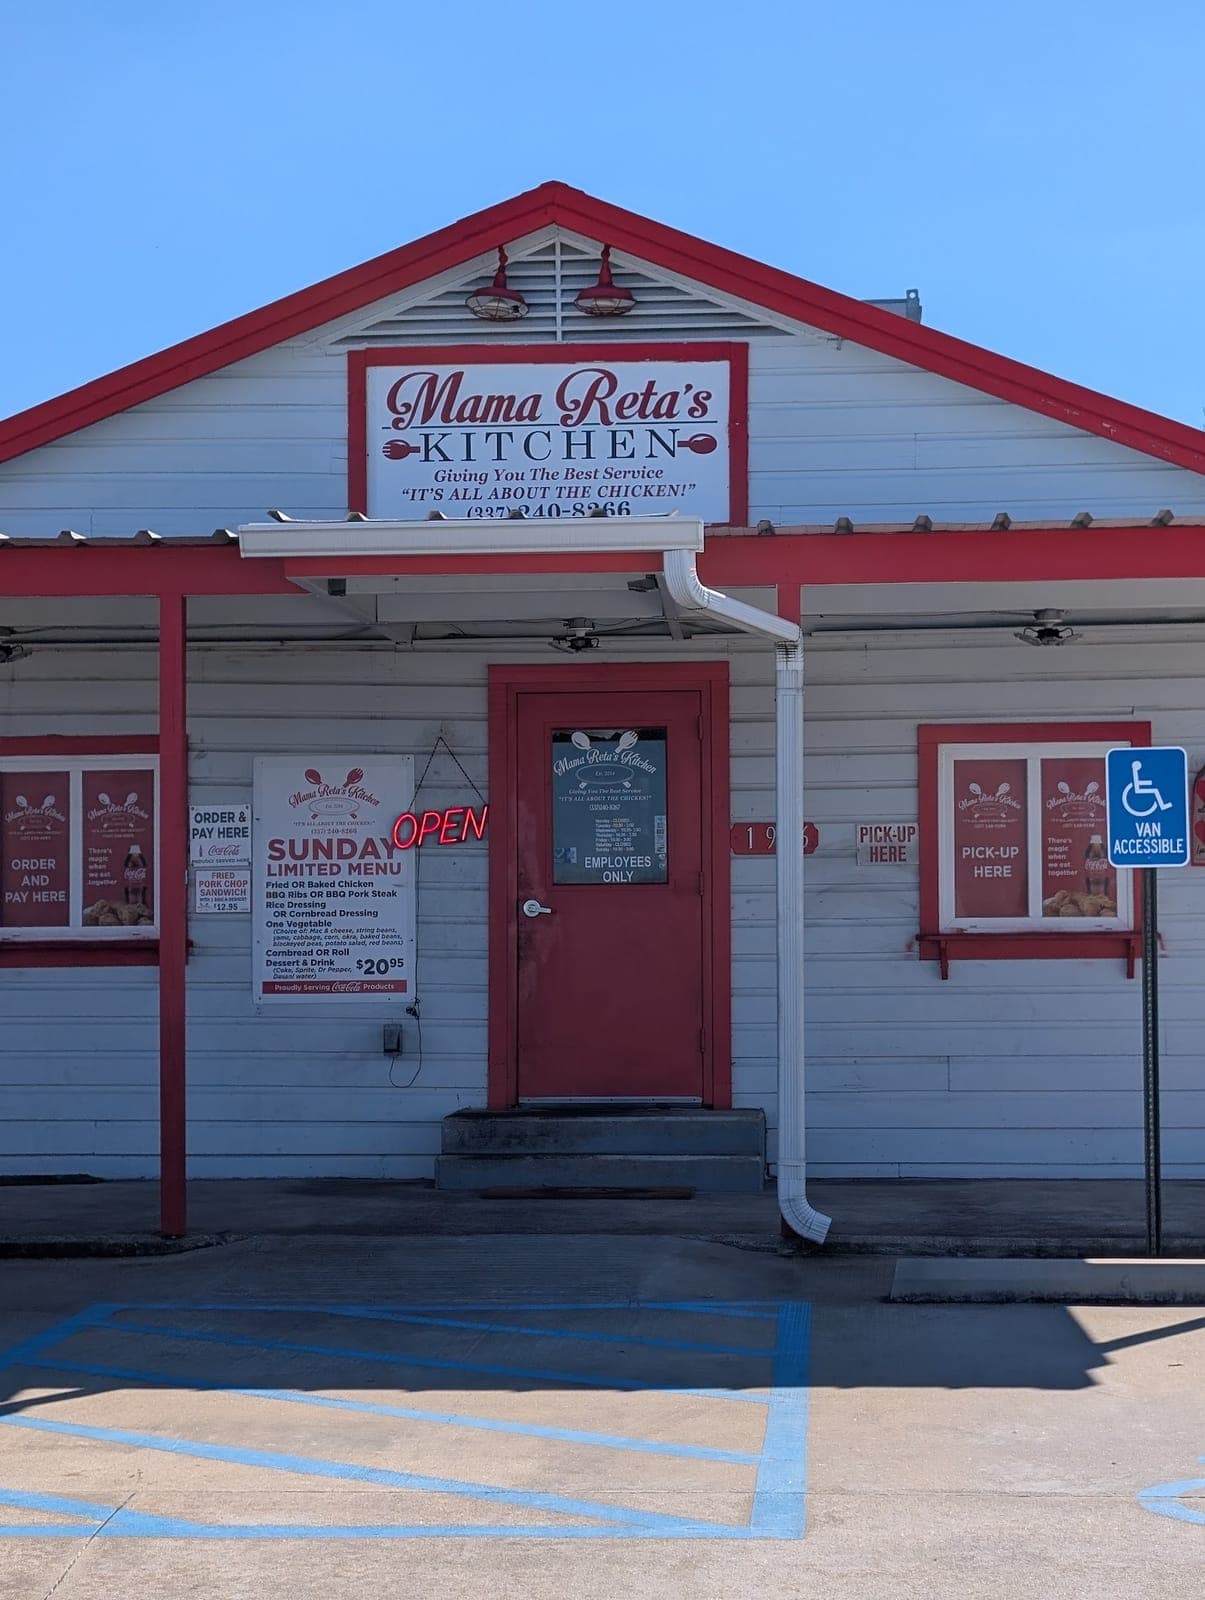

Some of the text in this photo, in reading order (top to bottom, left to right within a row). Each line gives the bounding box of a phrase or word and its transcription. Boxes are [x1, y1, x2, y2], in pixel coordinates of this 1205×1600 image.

[387, 367, 713, 430] Mama Reta's
[419, 428, 680, 462] KITCHEN
[434, 466, 664, 485] Giving You The Best Service
[448, 487, 483, 500] ALL
[488, 486, 550, 500] ABOUT
[556, 486, 591, 499] THE
[597, 483, 696, 498] CHICKEN!"
[553, 748, 657, 776] Mama Reta's Kitchen
[288, 784, 380, 808] Mama Reta's Kitchen
[194, 811, 247, 824] ORDER &
[192, 826, 249, 839] PAY HERE
[393, 806, 488, 848] OPEN
[1135, 822, 1161, 837] VAN
[746, 826, 809, 849] 196
[860, 826, 916, 843] PICK-UP
[267, 837, 396, 861] SUNDAY
[1113, 838, 1185, 854] ACCESSIBLE
[869, 846, 907, 863] HERE
[962, 847, 1019, 859] PICK-UP
[11, 859, 56, 870] ORDER
[585, 856, 652, 868] EMPLOYEES
[212, 872, 235, 880] FRIED
[267, 862, 402, 877] LIMITED MENU
[974, 865, 1012, 878] HERE
[21, 875, 49, 886] AND
[603, 871, 634, 882] ONLY
[199, 880, 248, 888] PORK CHOP
[266, 881, 289, 889] Fried
[308, 880, 335, 888] Baked
[338, 880, 374, 888] Chicken
[5, 890, 66, 903] PAY HERE
[200, 889, 246, 897] SANDWICH
[266, 891, 285, 899] BBQ
[288, 891, 308, 899] Ribs
[326, 890, 346, 898] BBQ
[348, 890, 369, 898] Pork
[371, 890, 397, 898] Steak
[266, 901, 326, 909] Rice Dressing
[273, 909, 378, 918] OR Cornbread Dressing
[287, 920, 332, 929] Vegetable
[266, 949, 313, 957] Cornbread
[332, 948, 349, 956] Roll
[266, 959, 300, 967] Dessert
[274, 984, 302, 992] Proudly
